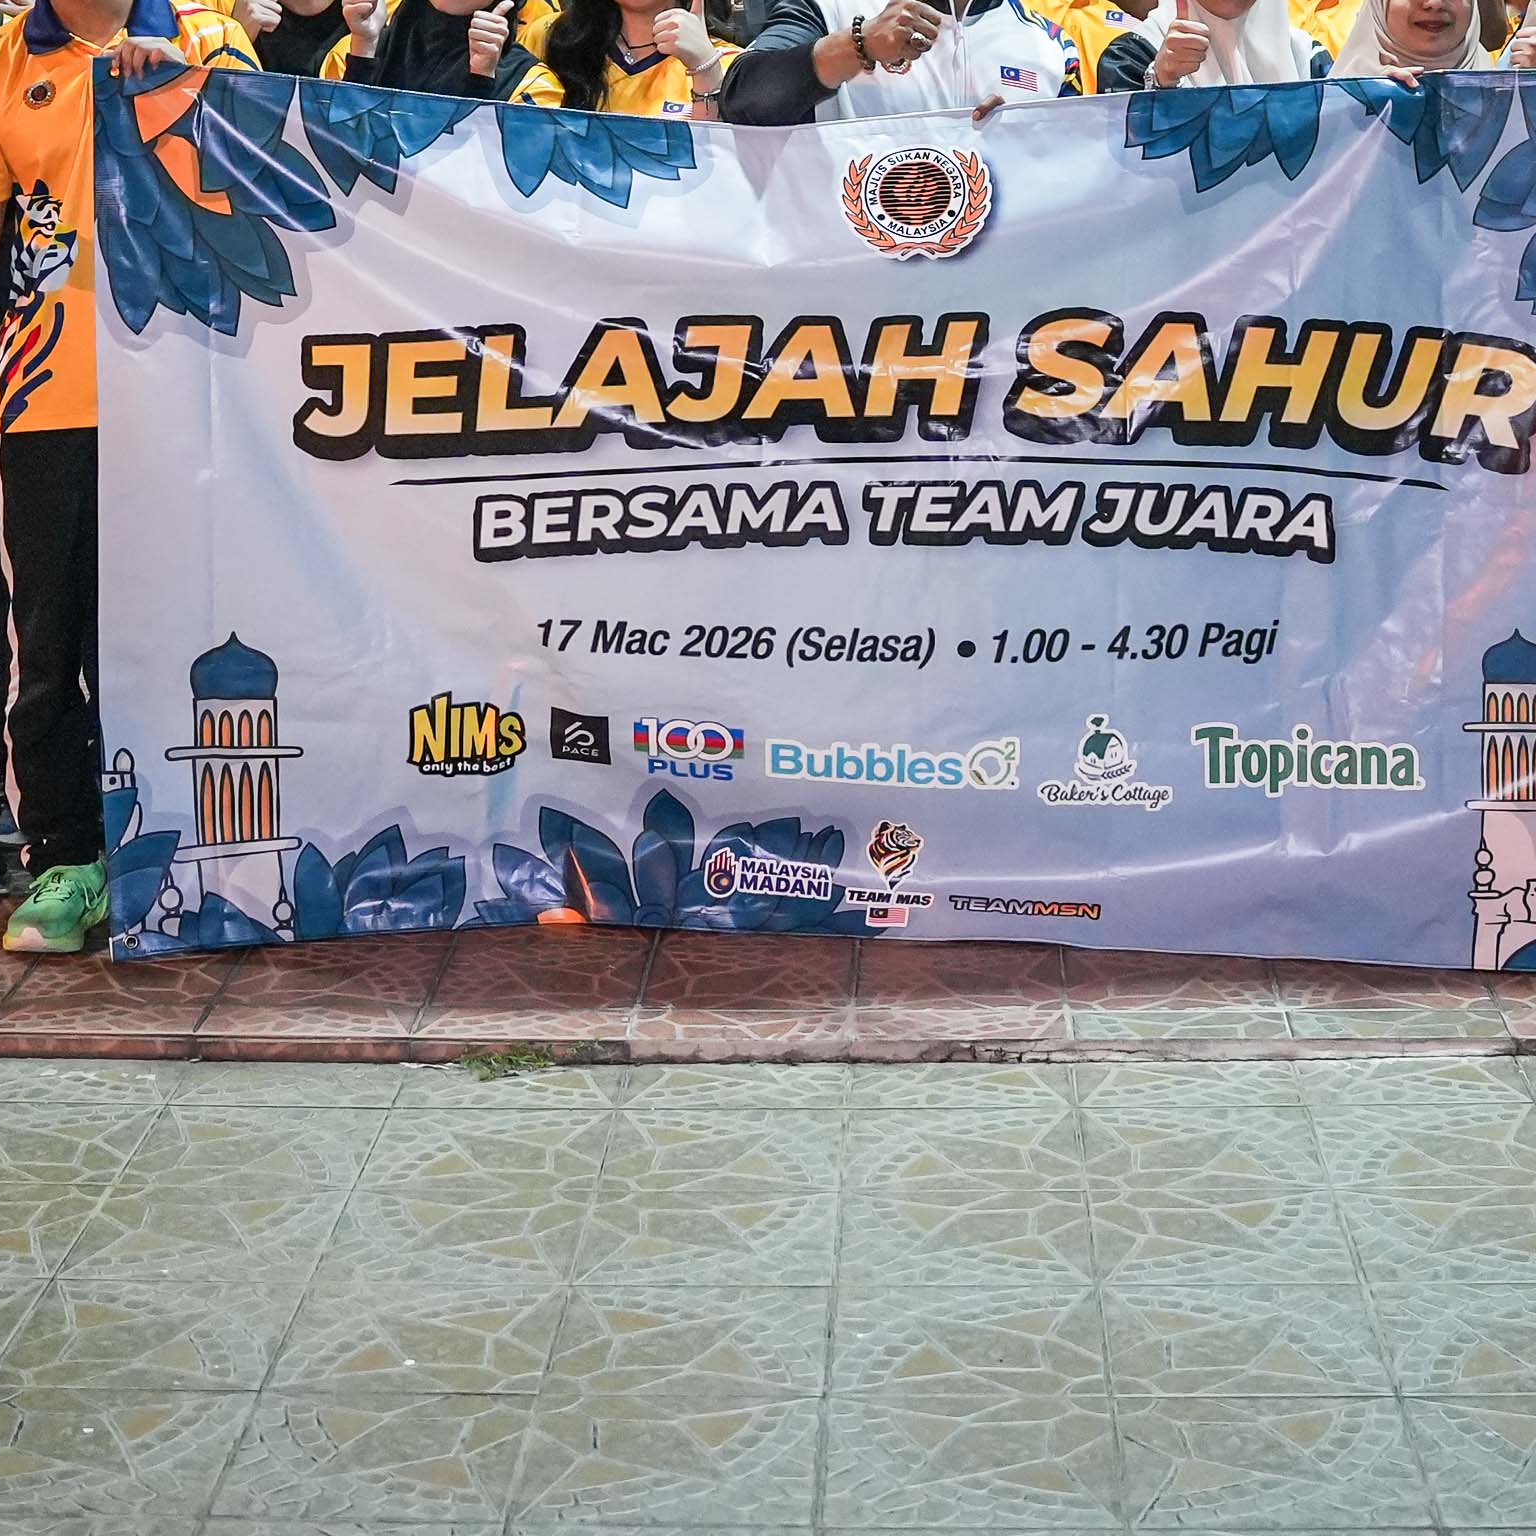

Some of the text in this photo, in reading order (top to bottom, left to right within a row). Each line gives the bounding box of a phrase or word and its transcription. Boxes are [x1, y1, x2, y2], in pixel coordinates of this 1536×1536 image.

[869, 151, 962, 206] MAJLIS SUKAN NEGARA
[887, 218, 948, 236] MALAYSIA
[300, 317, 980, 444] JELAJAH
[476, 480, 1332, 554] BERSAMA TEAM JUARA
[536, 619, 579, 651] 17
[591, 620, 670, 655] Mac
[680, 624, 775, 659] 2026
[785, 624, 936, 666] (Selasa)
[991, 629, 1065, 663] 1.00
[1108, 624, 1189, 660] 4.30
[1196, 620, 1279, 665] Pagi
[411, 695, 524, 763] NIMS
[639, 717, 735, 761] 100
[561, 745, 600, 757] PACE
[1194, 727, 1415, 794] Tropicana
[421, 757, 512, 775] only the best
[647, 759, 734, 782] PLUS
[1040, 783, 1170, 808] Baker's Cottage
[739, 859, 830, 881] MALAYSIA
[739, 875, 830, 898] MADANI
[847, 890, 932, 906] TEAM MAS
